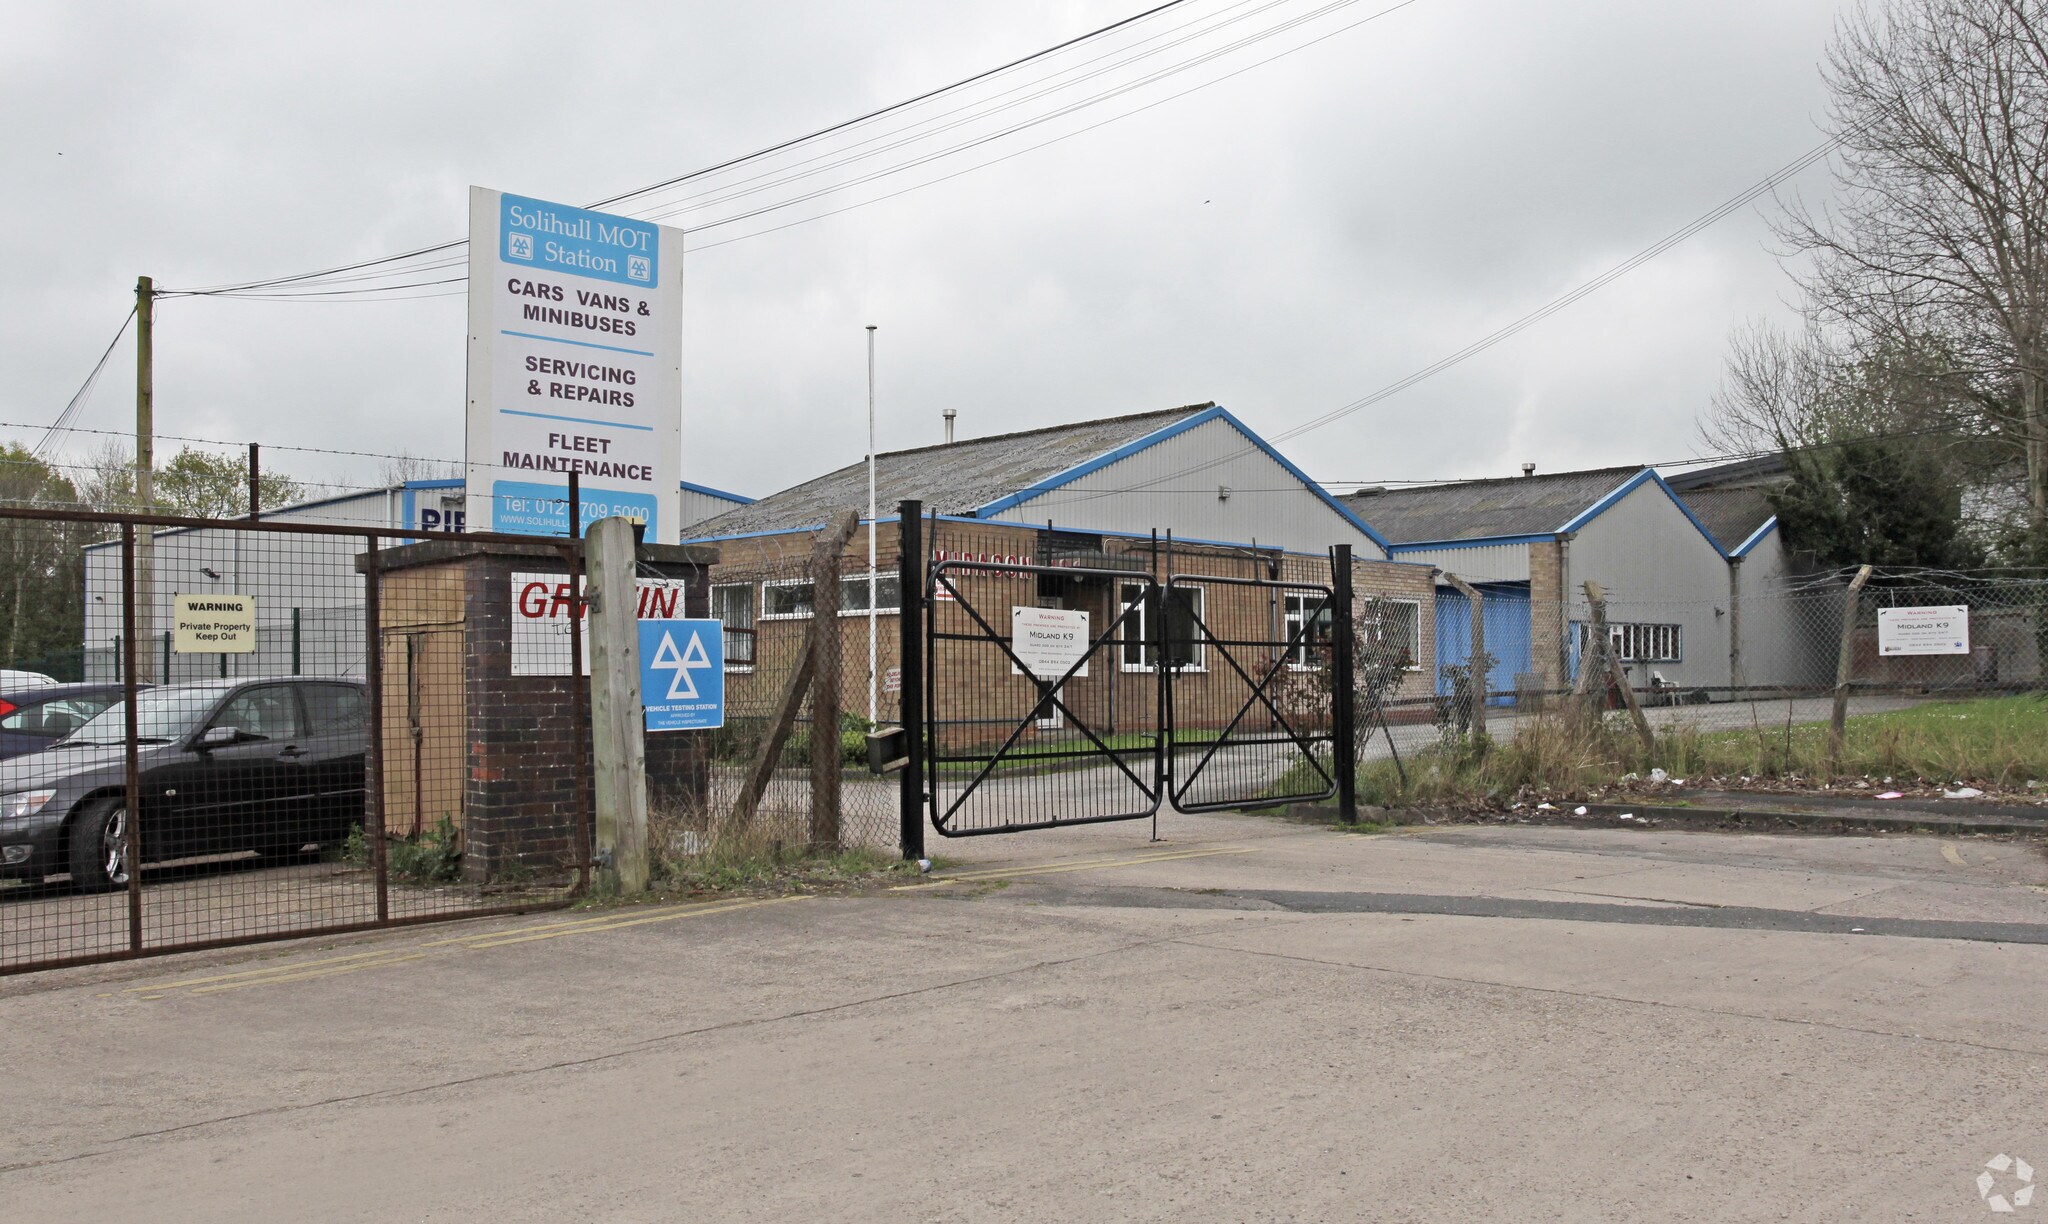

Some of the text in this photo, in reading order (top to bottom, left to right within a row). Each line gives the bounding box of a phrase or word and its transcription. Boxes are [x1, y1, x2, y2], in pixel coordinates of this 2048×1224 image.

[510, 205, 651, 252] Solihull MOT
[545, 241, 618, 274] Station
[507, 278, 650, 317] CARS VANS &
[523, 303, 637, 337] MINIBUSES
[525, 355, 636, 386] SERVICING
[527, 379, 635, 408] & REPAIRS
[549, 433, 611, 454] FLEET
[503, 451, 652, 482] MAINTENANCE
[502, 495, 650, 523] Tel: 012 709 5000
[188, 602, 243, 612] WARNING
[180, 622, 251, 632] Private Property
[196, 633, 218, 641] Keep
[1029, 631, 1061, 640] MIDLAND
